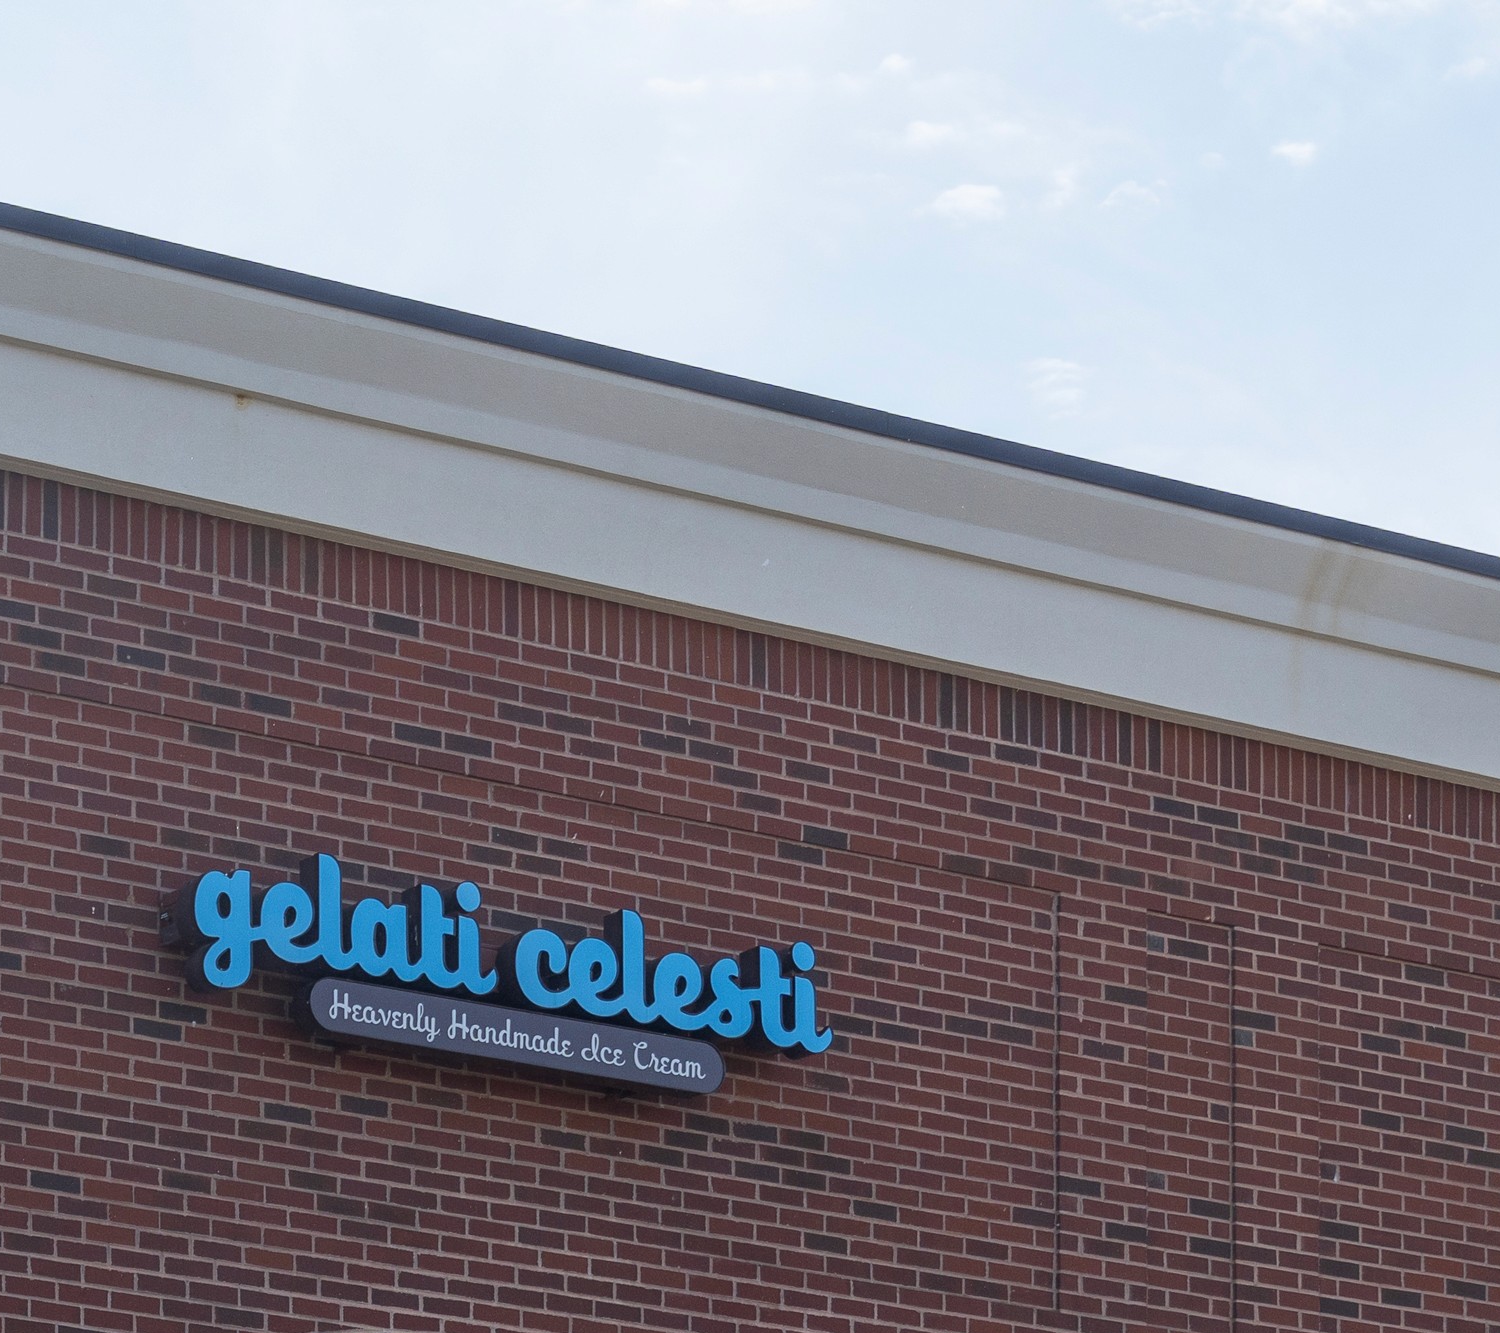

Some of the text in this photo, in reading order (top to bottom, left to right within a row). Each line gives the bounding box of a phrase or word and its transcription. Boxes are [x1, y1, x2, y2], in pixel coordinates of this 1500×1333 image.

[184, 852, 832, 1056] gelati celesti
[328, 988, 706, 1081] Heavenly Handmade Ice Cream
